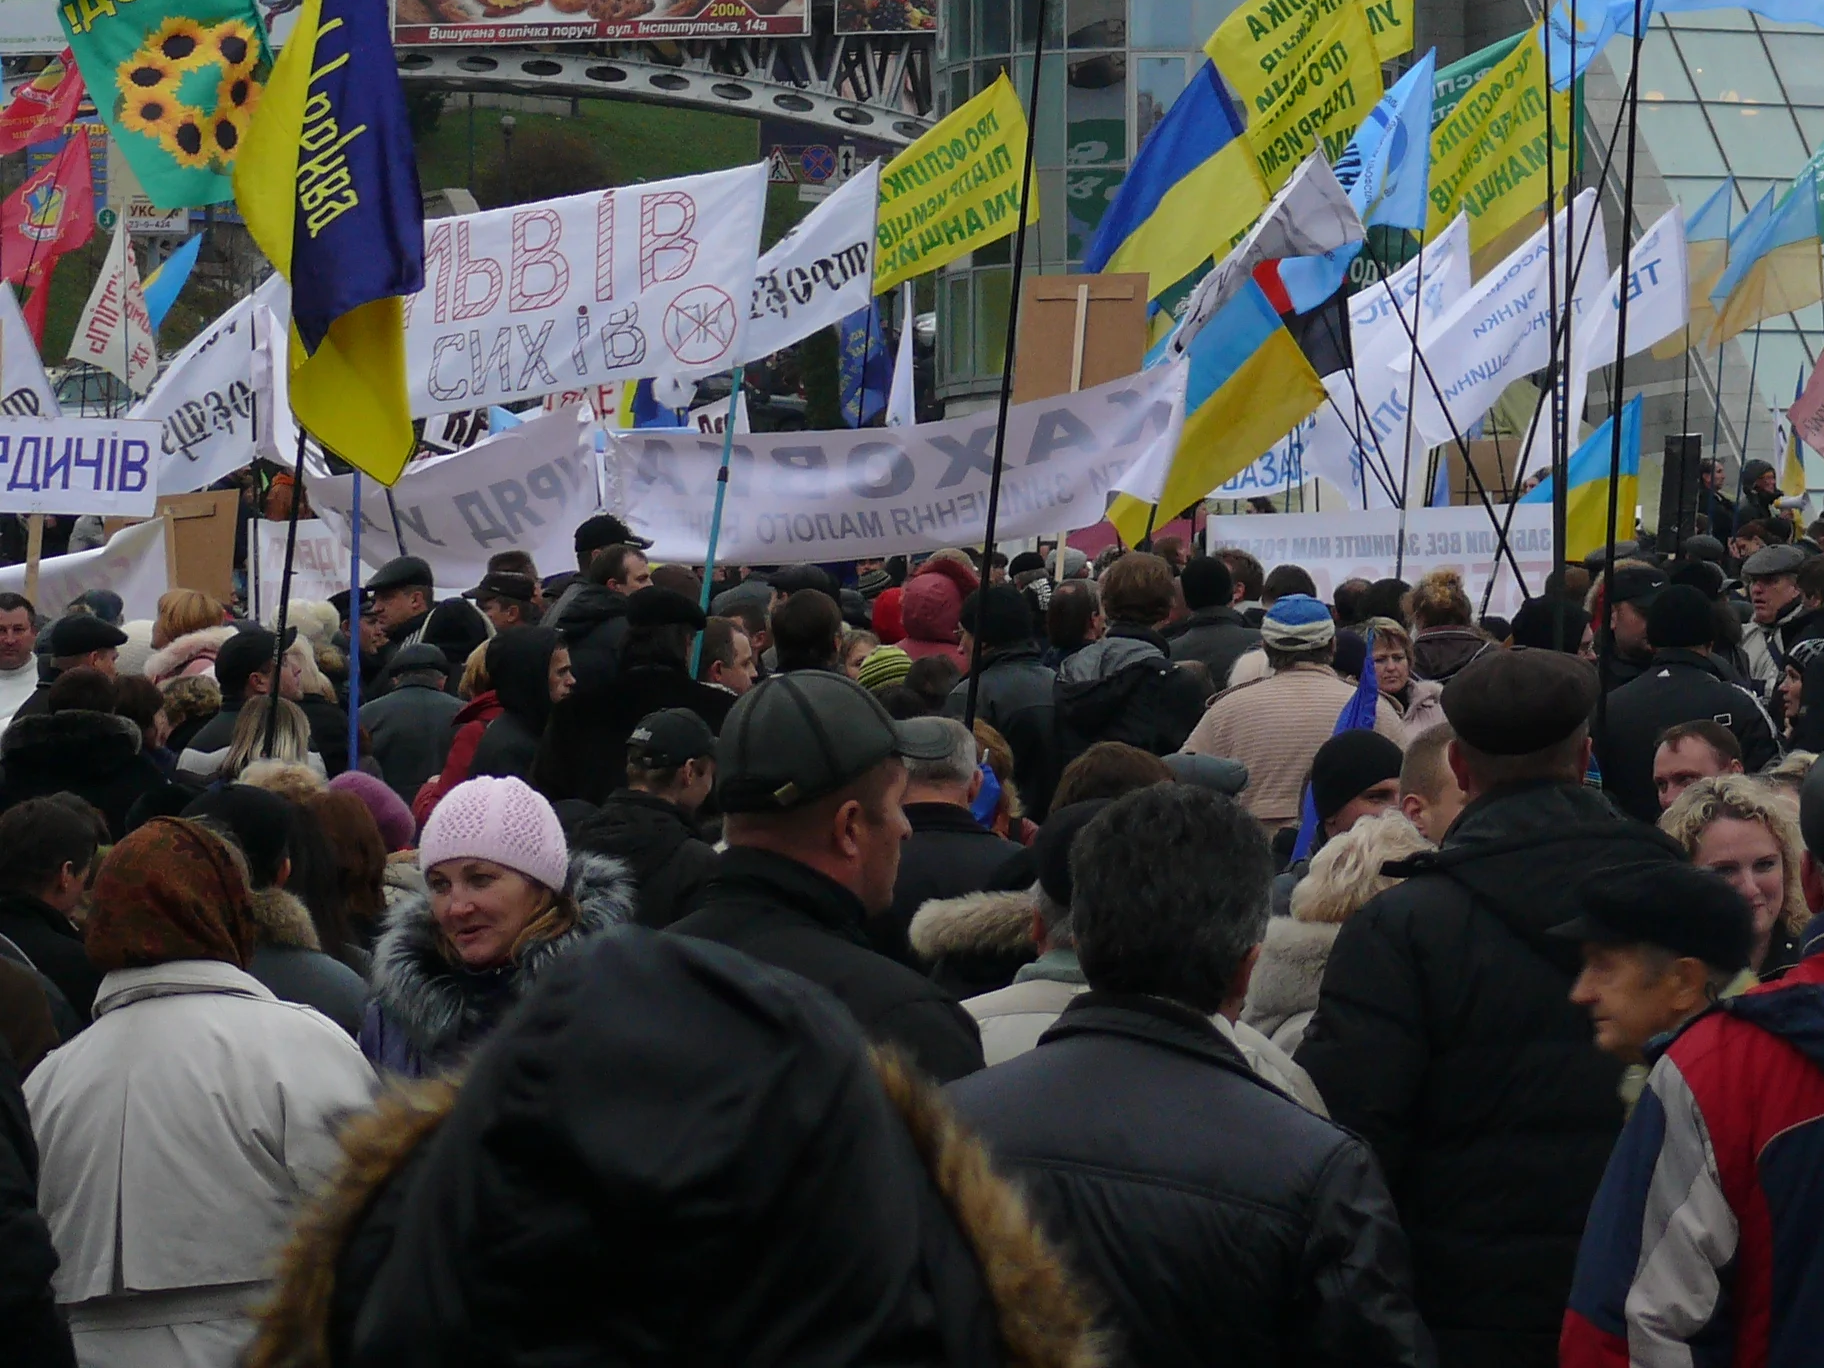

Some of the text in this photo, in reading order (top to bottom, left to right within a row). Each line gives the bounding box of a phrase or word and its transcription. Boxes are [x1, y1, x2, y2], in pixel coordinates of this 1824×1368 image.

[710, 3, 746, 18] 200м
[428, 27, 494, 41] Вишукана
[498, 26, 549, 39] випічка
[552, 25, 597, 39] поруч!
[606, 24, 634, 37] вул.
[637, 18, 742, 36] Інститутська,
